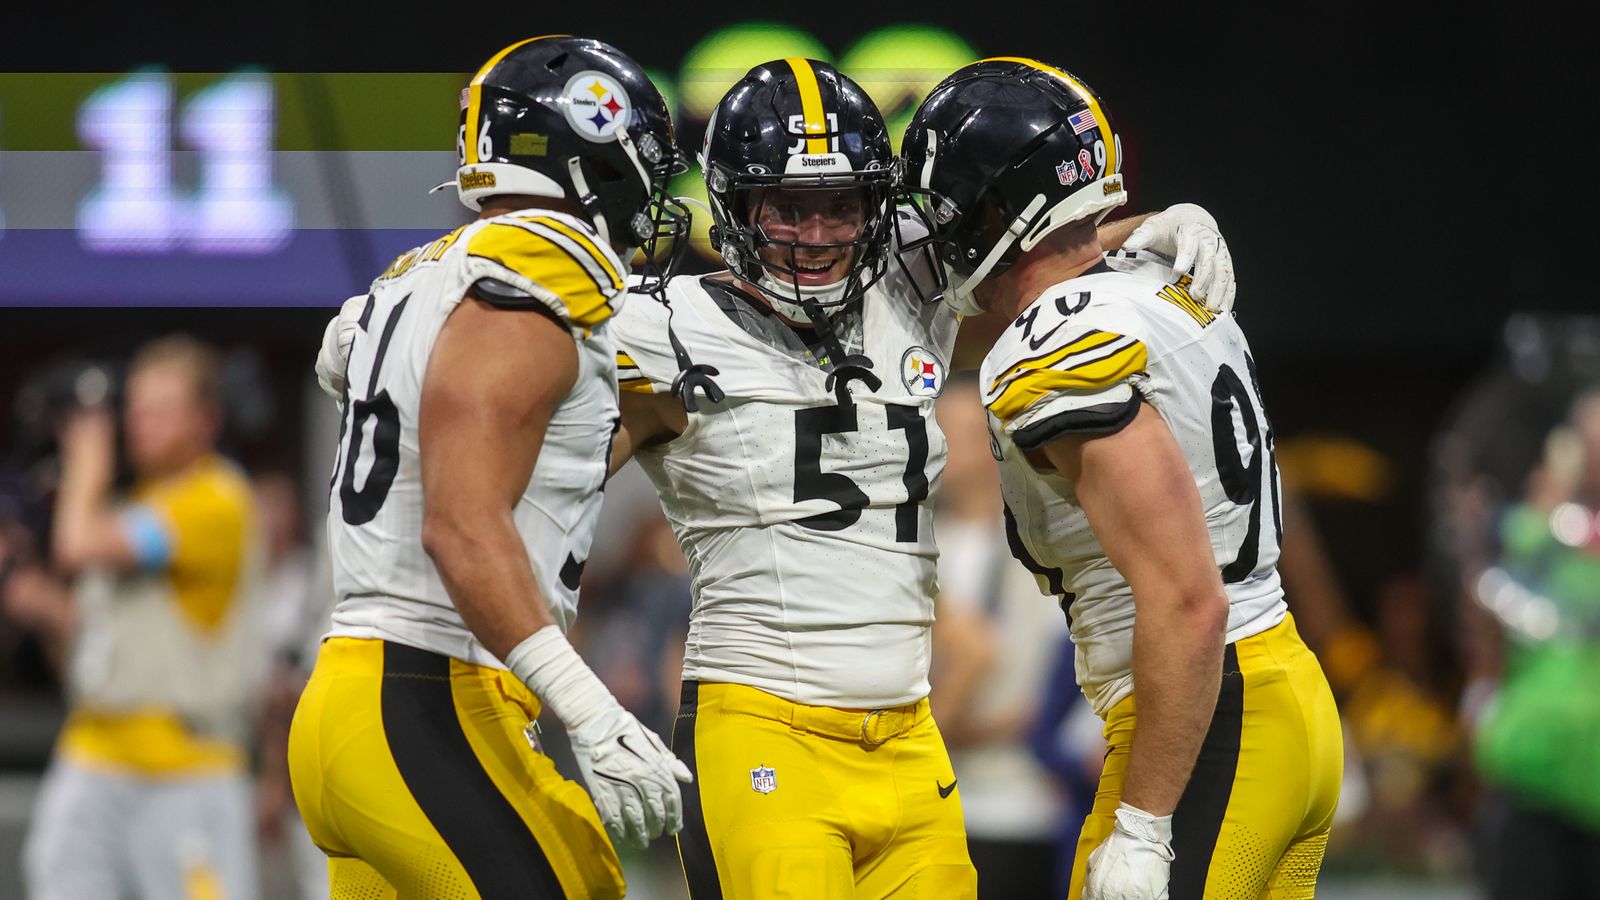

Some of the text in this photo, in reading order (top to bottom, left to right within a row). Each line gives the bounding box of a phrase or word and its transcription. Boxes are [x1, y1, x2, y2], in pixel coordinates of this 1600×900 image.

[78, 67, 294, 254] 11
[787, 113, 840, 154] 51
[801, 157, 837, 167] Steelers
[794, 403, 929, 542] 51
